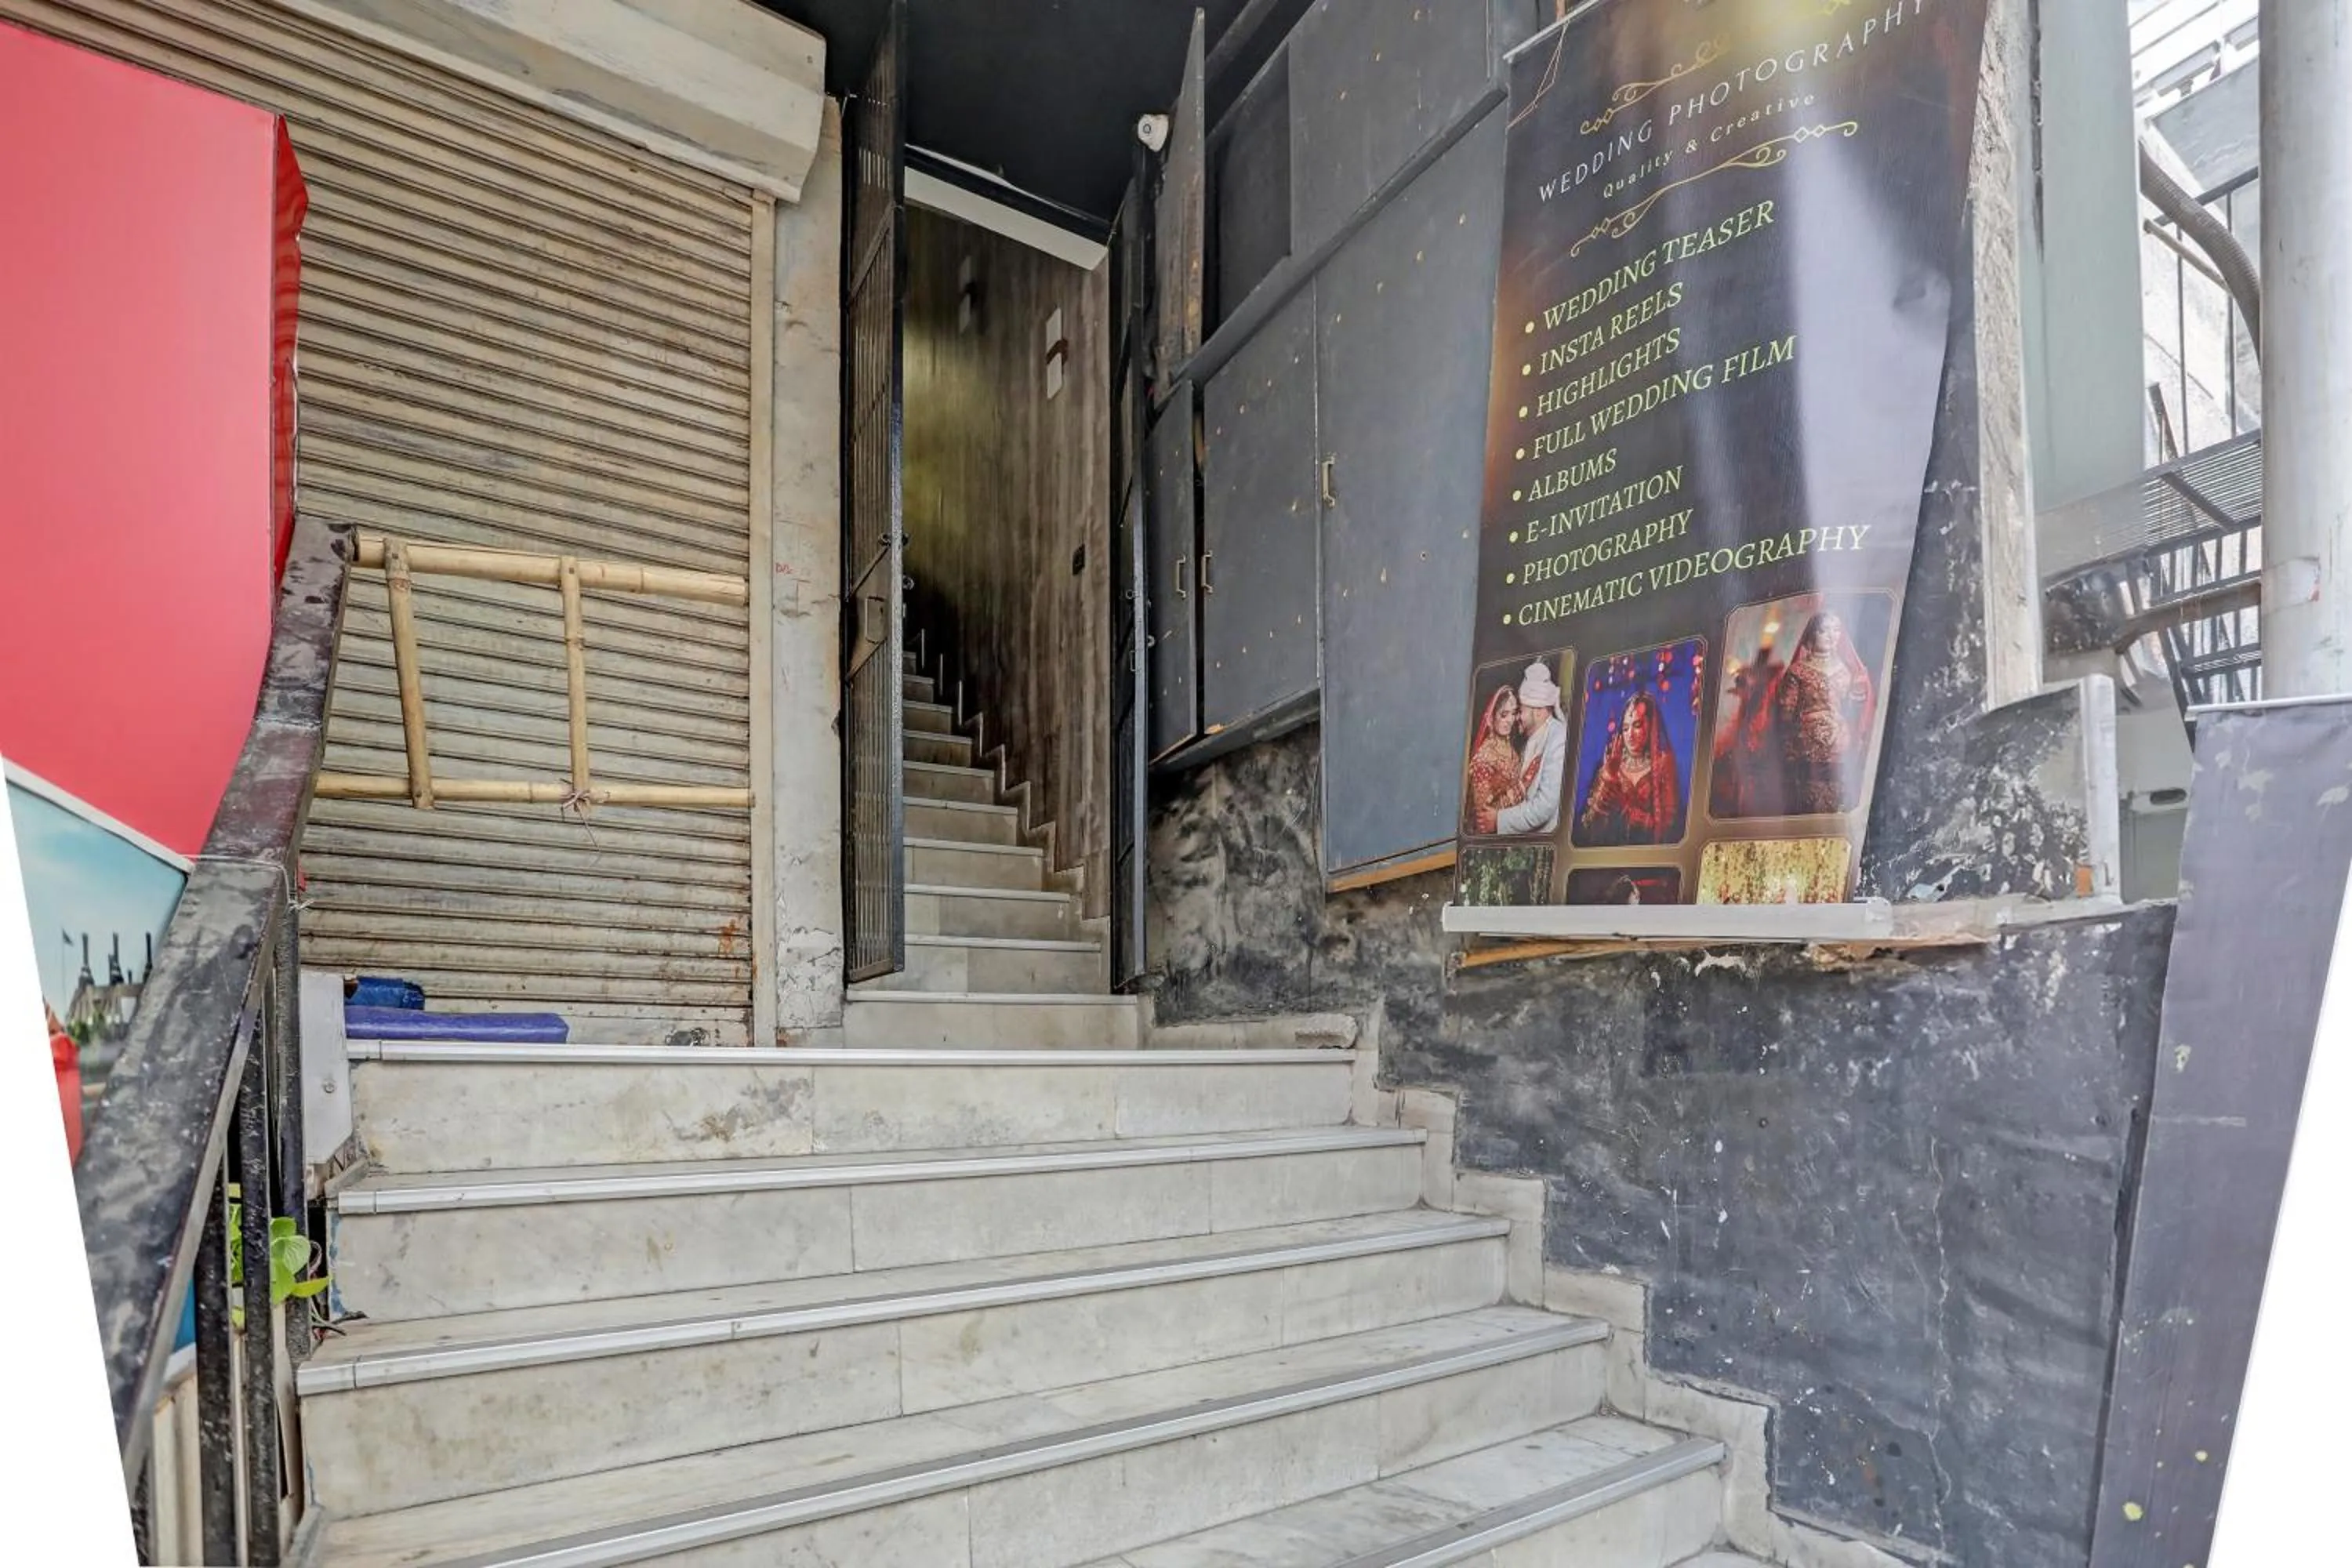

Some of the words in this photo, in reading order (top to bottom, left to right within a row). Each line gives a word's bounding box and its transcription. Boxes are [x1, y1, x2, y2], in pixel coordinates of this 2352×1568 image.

[1538, 119, 1653, 202] WEDDING
[1603, 149, 1674, 199] Quality
[1685, 138, 1698, 154] &
[1711, 93, 1816, 143] Creative
[1543, 249, 1657, 331] WEDDING
[1662, 199, 1775, 265] TEASER
[1536, 327, 1682, 417] HIGHLIGHTS
[1539, 329, 1605, 375] INSTA
[1610, 282, 1685, 341] REELS
[1532, 422, 1585, 461] FULL
[1590, 364, 1715, 437] WEDDING
[1721, 335, 1798, 384] FILM
[1526, 465, 1685, 544] E-INVITATION
[1527, 448, 1618, 503] ALBUMS
[1517, 571, 1644, 627] CINEMATIC
[1648, 524, 1871, 591] VIDEOGRAPHY
[1521, 508, 1694, 586] PHOTOGRAPHY
